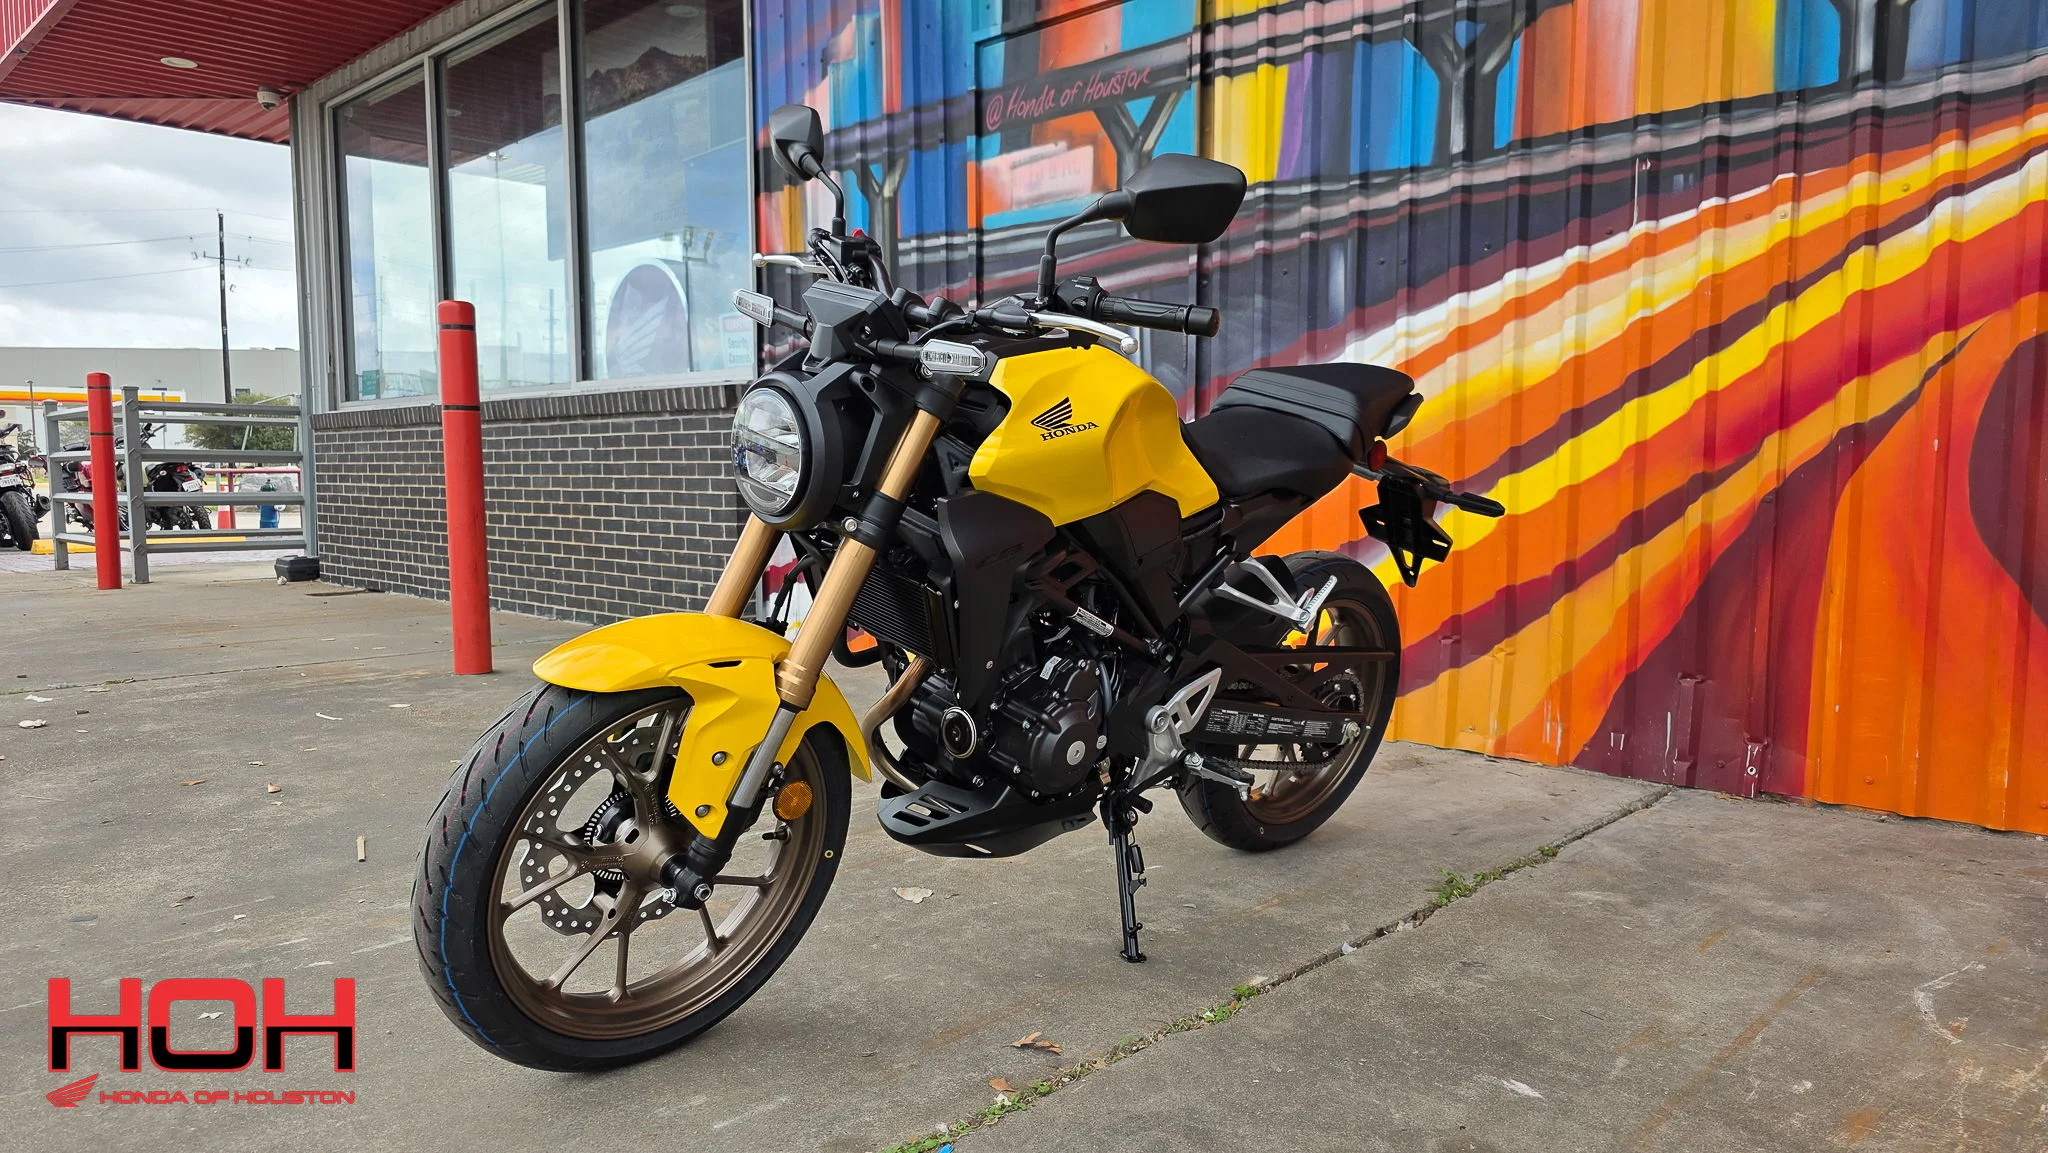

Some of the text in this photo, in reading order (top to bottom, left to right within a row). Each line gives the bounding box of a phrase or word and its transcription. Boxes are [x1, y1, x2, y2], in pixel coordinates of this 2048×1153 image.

[986, 63, 1151, 131] @ Honda of Houston
[1040, 421, 1100, 442] HONDA
